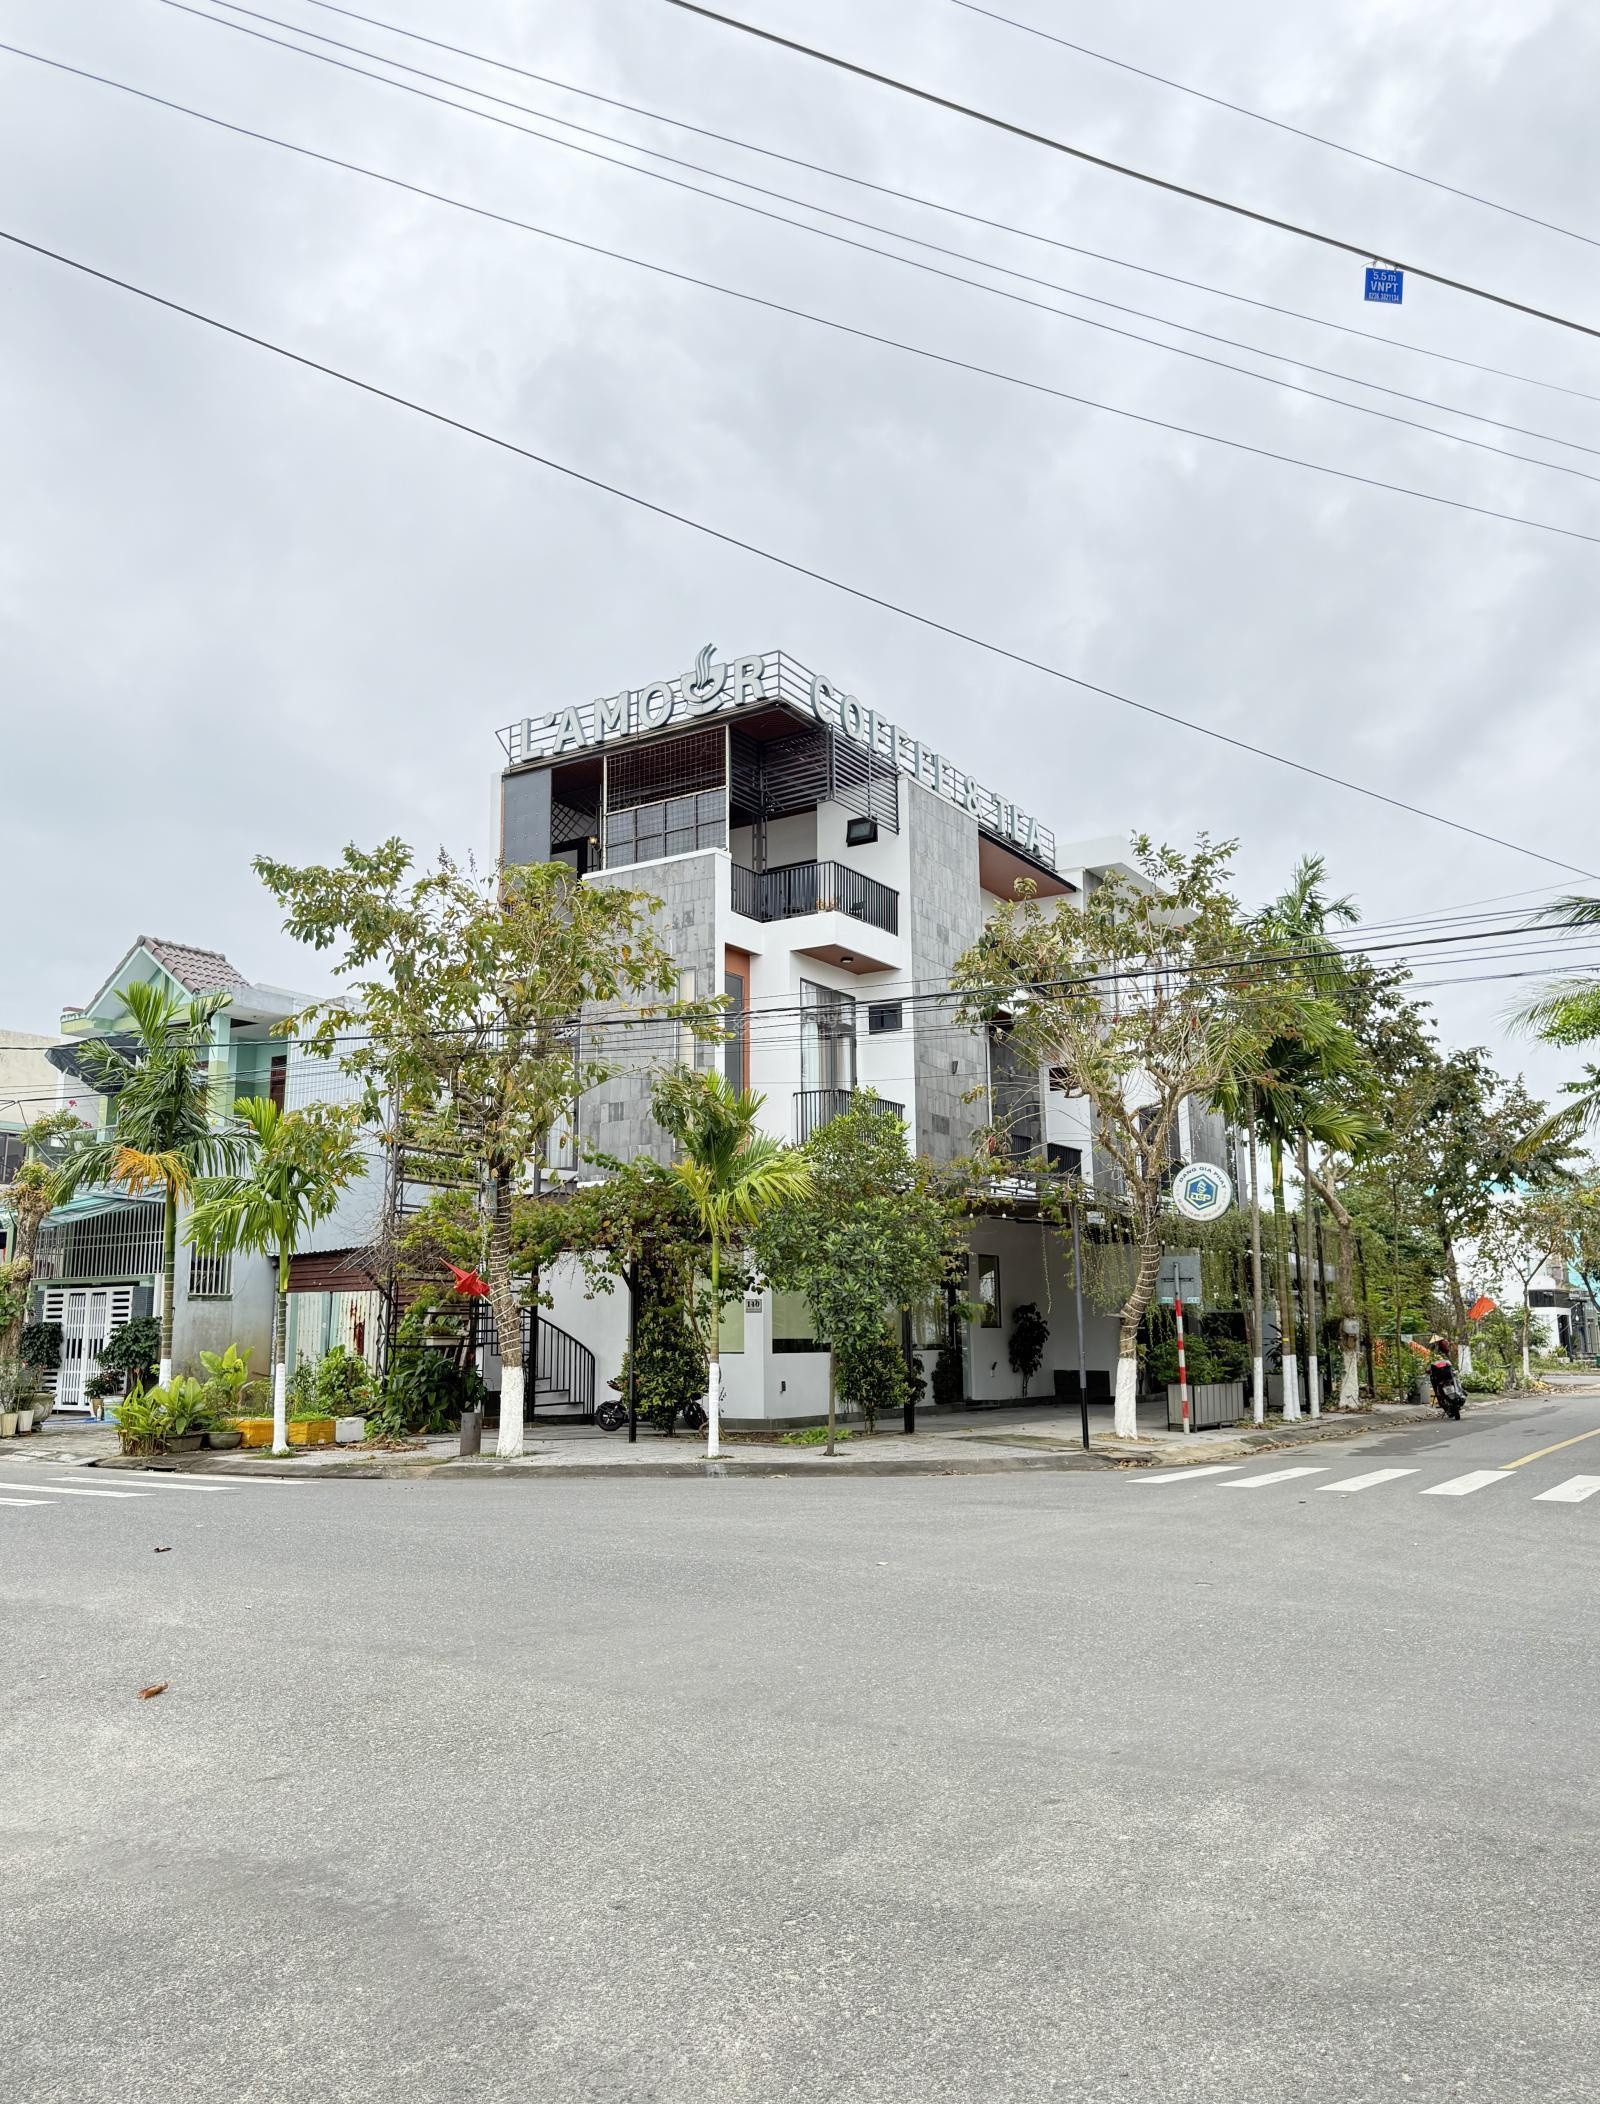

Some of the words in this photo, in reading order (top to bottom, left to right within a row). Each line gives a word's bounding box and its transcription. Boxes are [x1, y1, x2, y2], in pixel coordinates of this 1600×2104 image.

[1370, 280, 1399, 293] VNPT
[520, 644, 766, 762] L'AMOUR
[810, 675, 954, 802] COFFEE
[963, 776, 982, 819] &
[991, 793, 1044, 859] TEA
